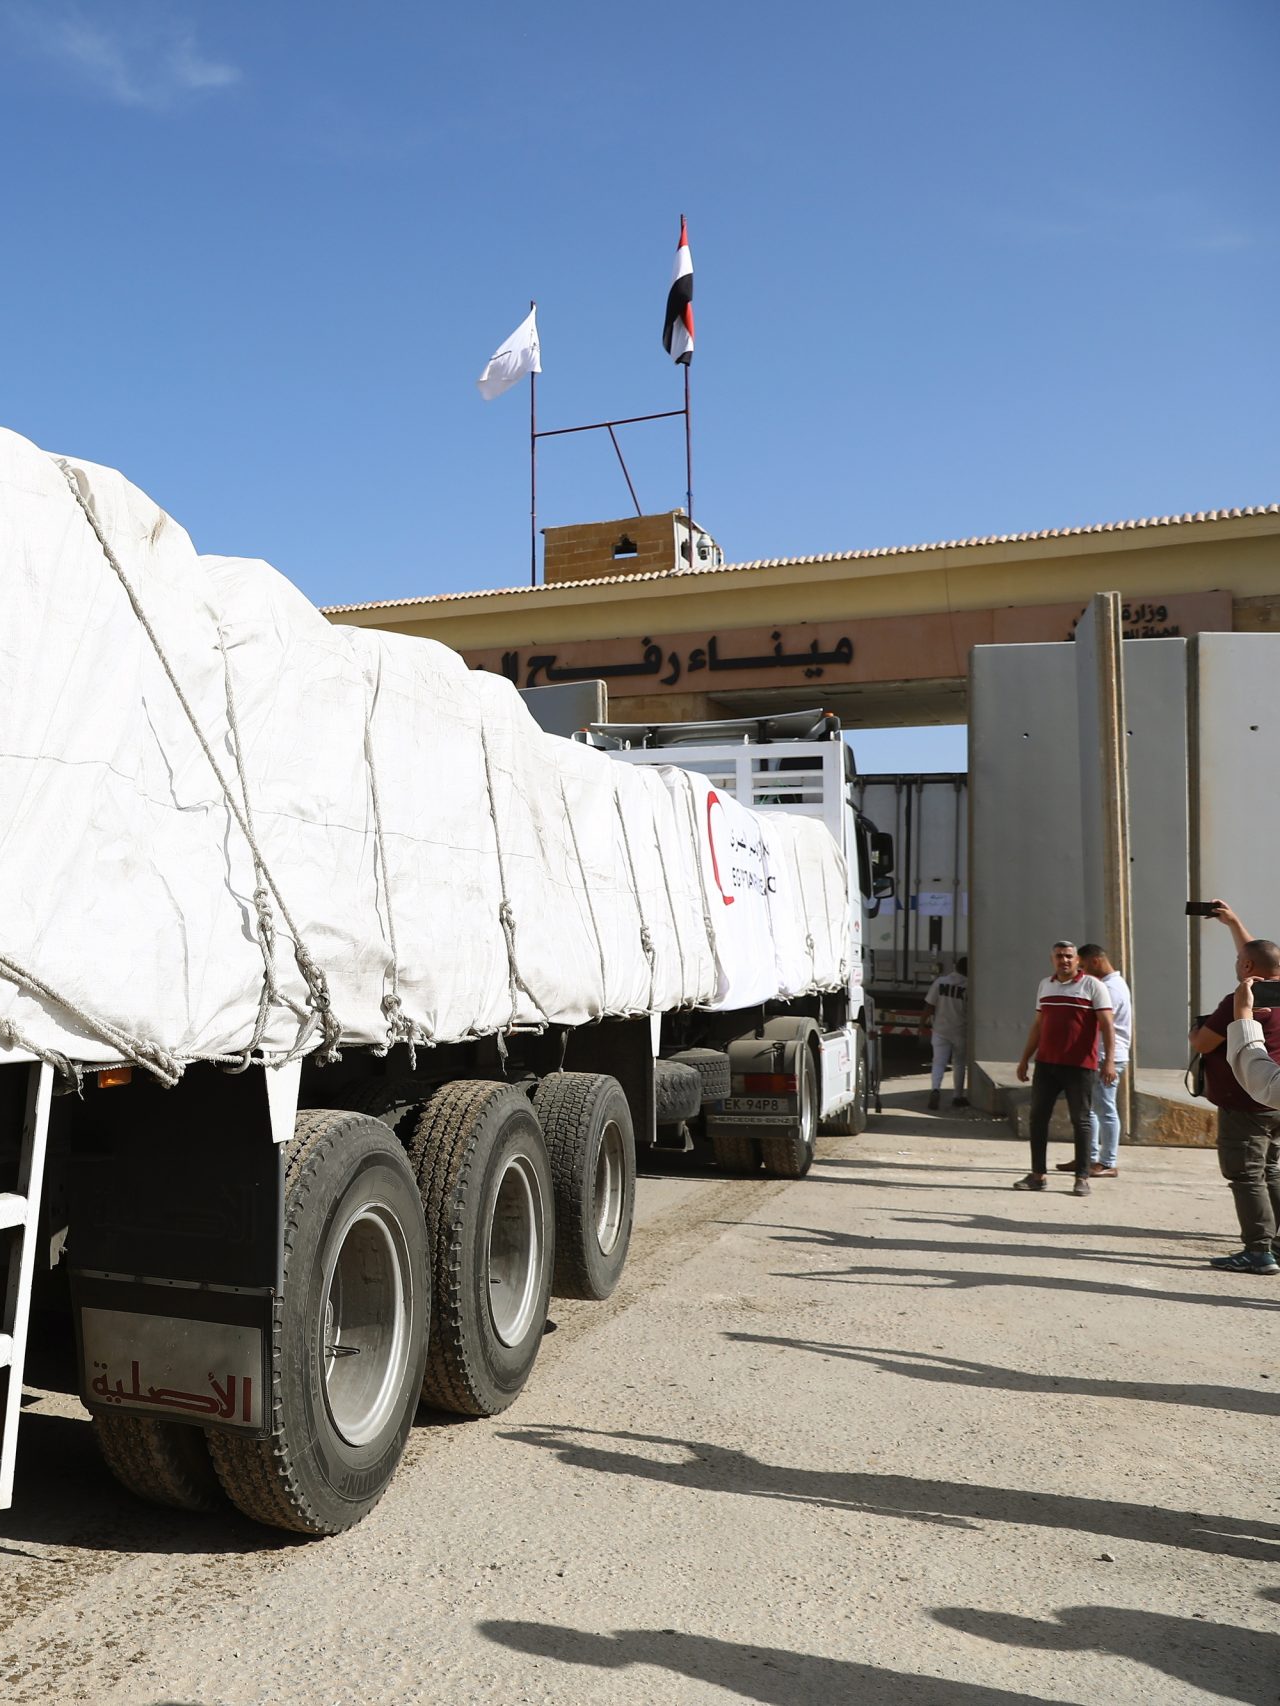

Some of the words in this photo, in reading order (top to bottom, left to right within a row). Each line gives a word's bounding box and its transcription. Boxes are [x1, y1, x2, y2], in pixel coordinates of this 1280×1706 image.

[527, 636, 681, 687] رفح
[688, 631, 853, 679] ميناء
[92, 1361, 252, 1422] الأصلية
